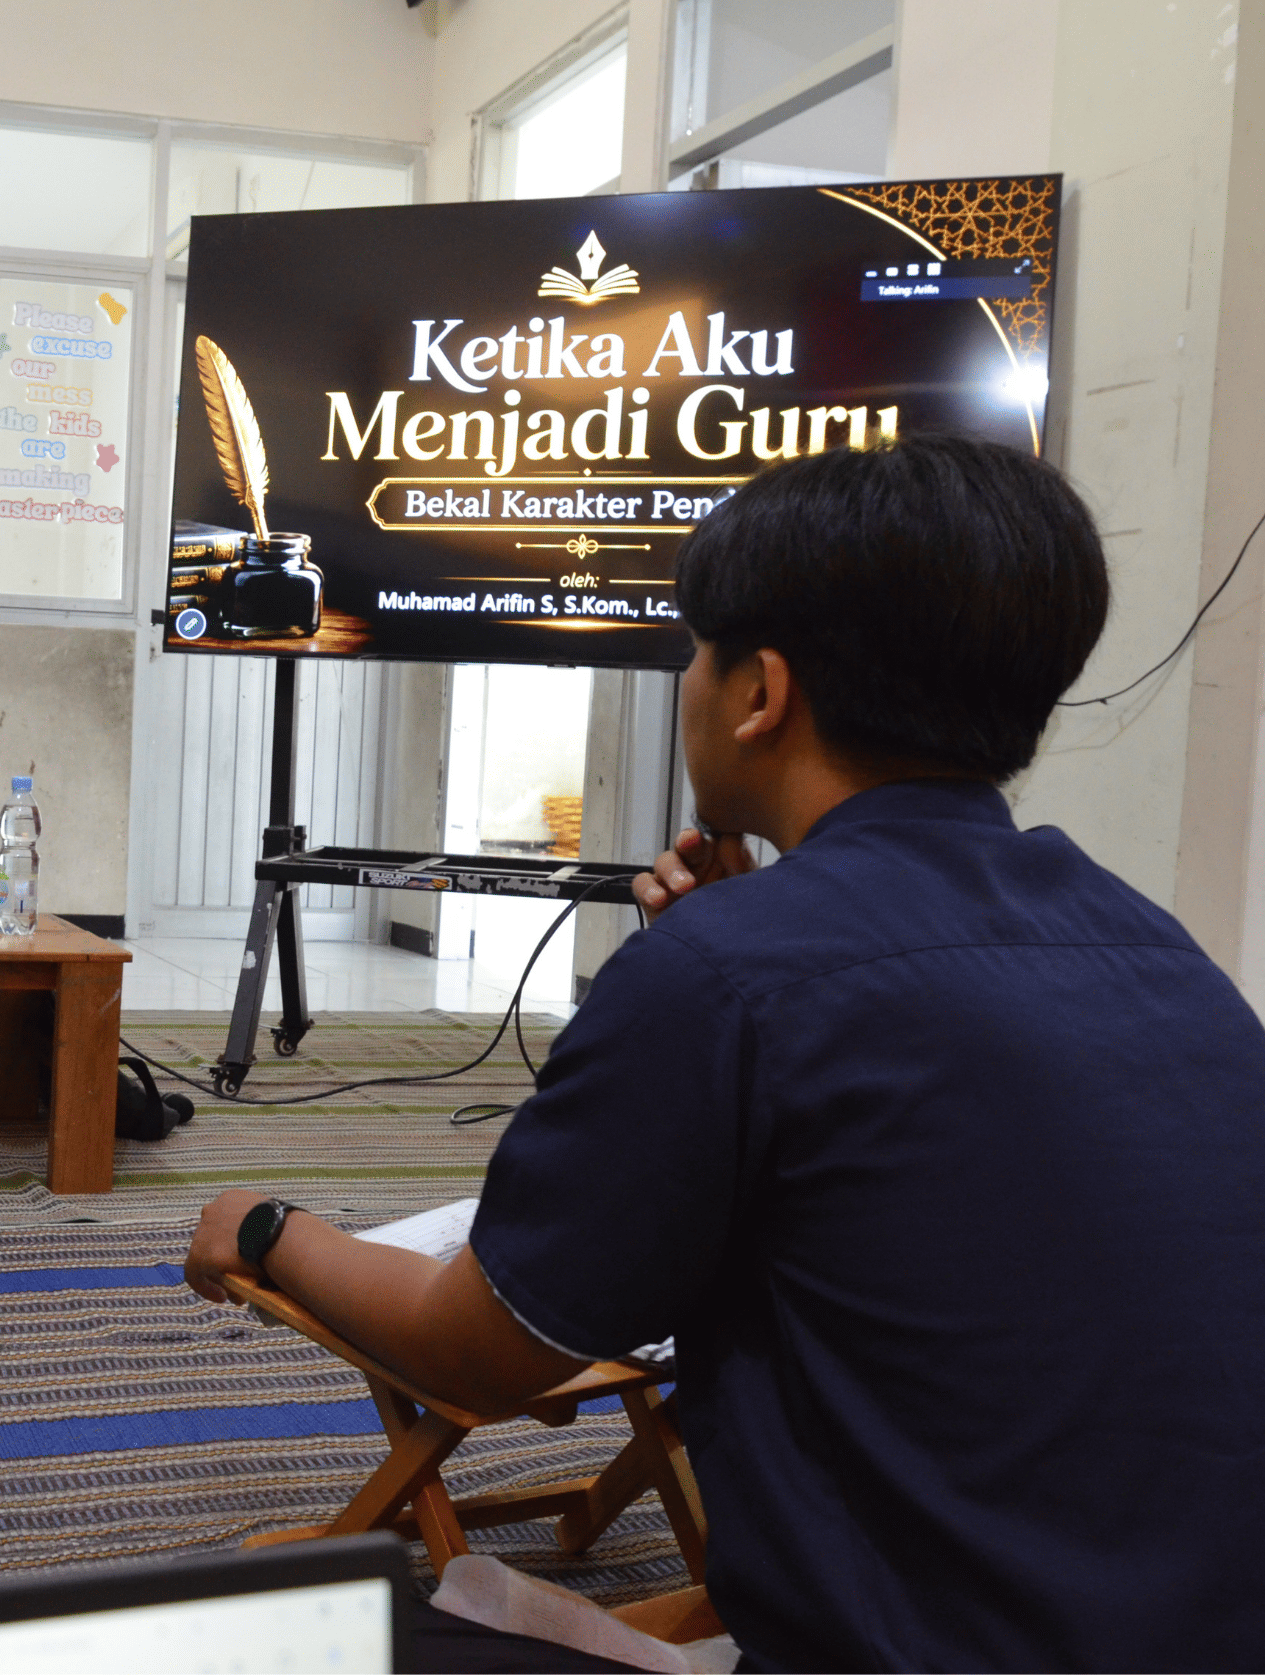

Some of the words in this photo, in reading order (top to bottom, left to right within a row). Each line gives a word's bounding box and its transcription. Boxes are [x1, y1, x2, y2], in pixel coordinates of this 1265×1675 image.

[913, 284, 940, 295] Arifin
[14, 301, 94, 334] Please
[31, 335, 113, 359] excuse
[409, 316, 626, 394] Ketika
[643, 310, 795, 379] Aku
[11, 358, 56, 379] our
[26, 383, 94, 406] mess
[48, 410, 102, 438] kids
[324, 386, 650, 477] Menjadi
[21, 438, 66, 460] are
[404, 488, 491, 519] Bekal
[500, 488, 643, 520] Karakter
[559, 572, 601, 590] oleh:
[377, 590, 476, 612] Muhamad
[479, 591, 536, 613] Arifin
[540, 593, 558, 616] S,
[563, 594, 639, 618] S.Kom.,
[368, 871, 411, 881] SUZUKI
[369, 877, 408, 886] SPORT
